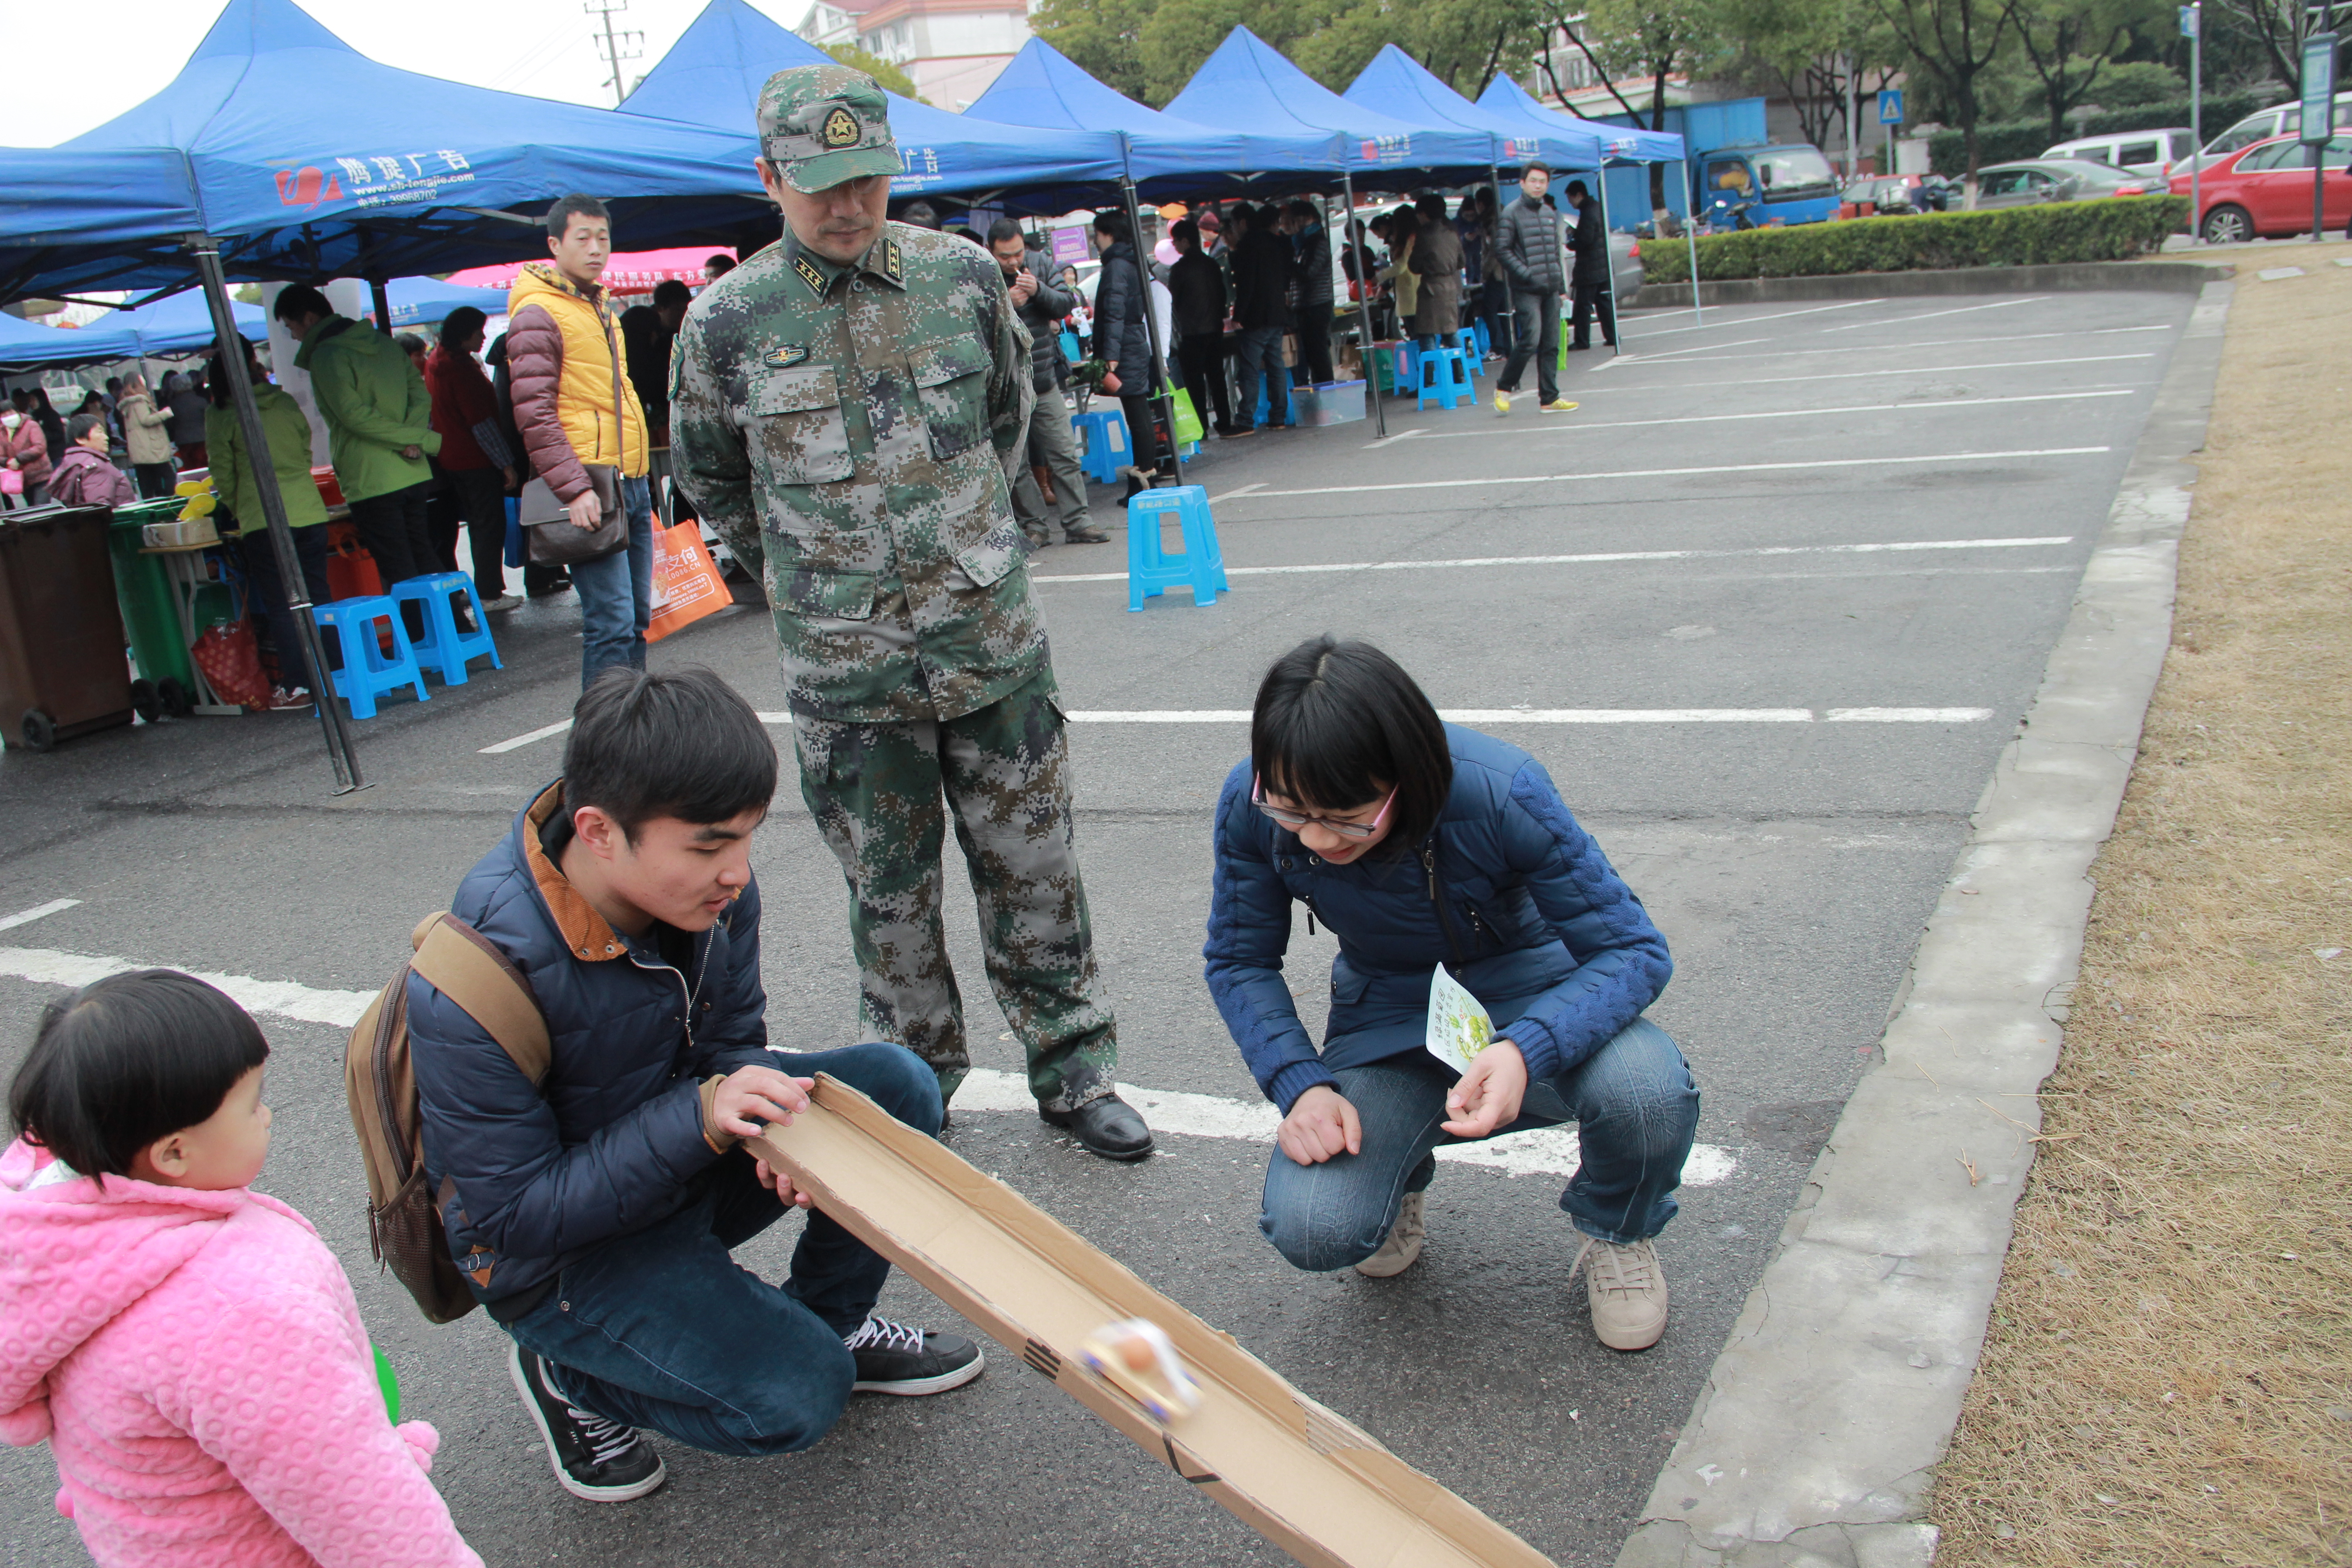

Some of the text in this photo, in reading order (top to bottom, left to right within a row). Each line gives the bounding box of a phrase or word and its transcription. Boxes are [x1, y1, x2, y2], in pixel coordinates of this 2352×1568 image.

[336, 150, 470, 185] 腾捷广告
[905, 147, 938, 173] 广告
[353, 172, 475, 196] www.sh-tengjie.com
